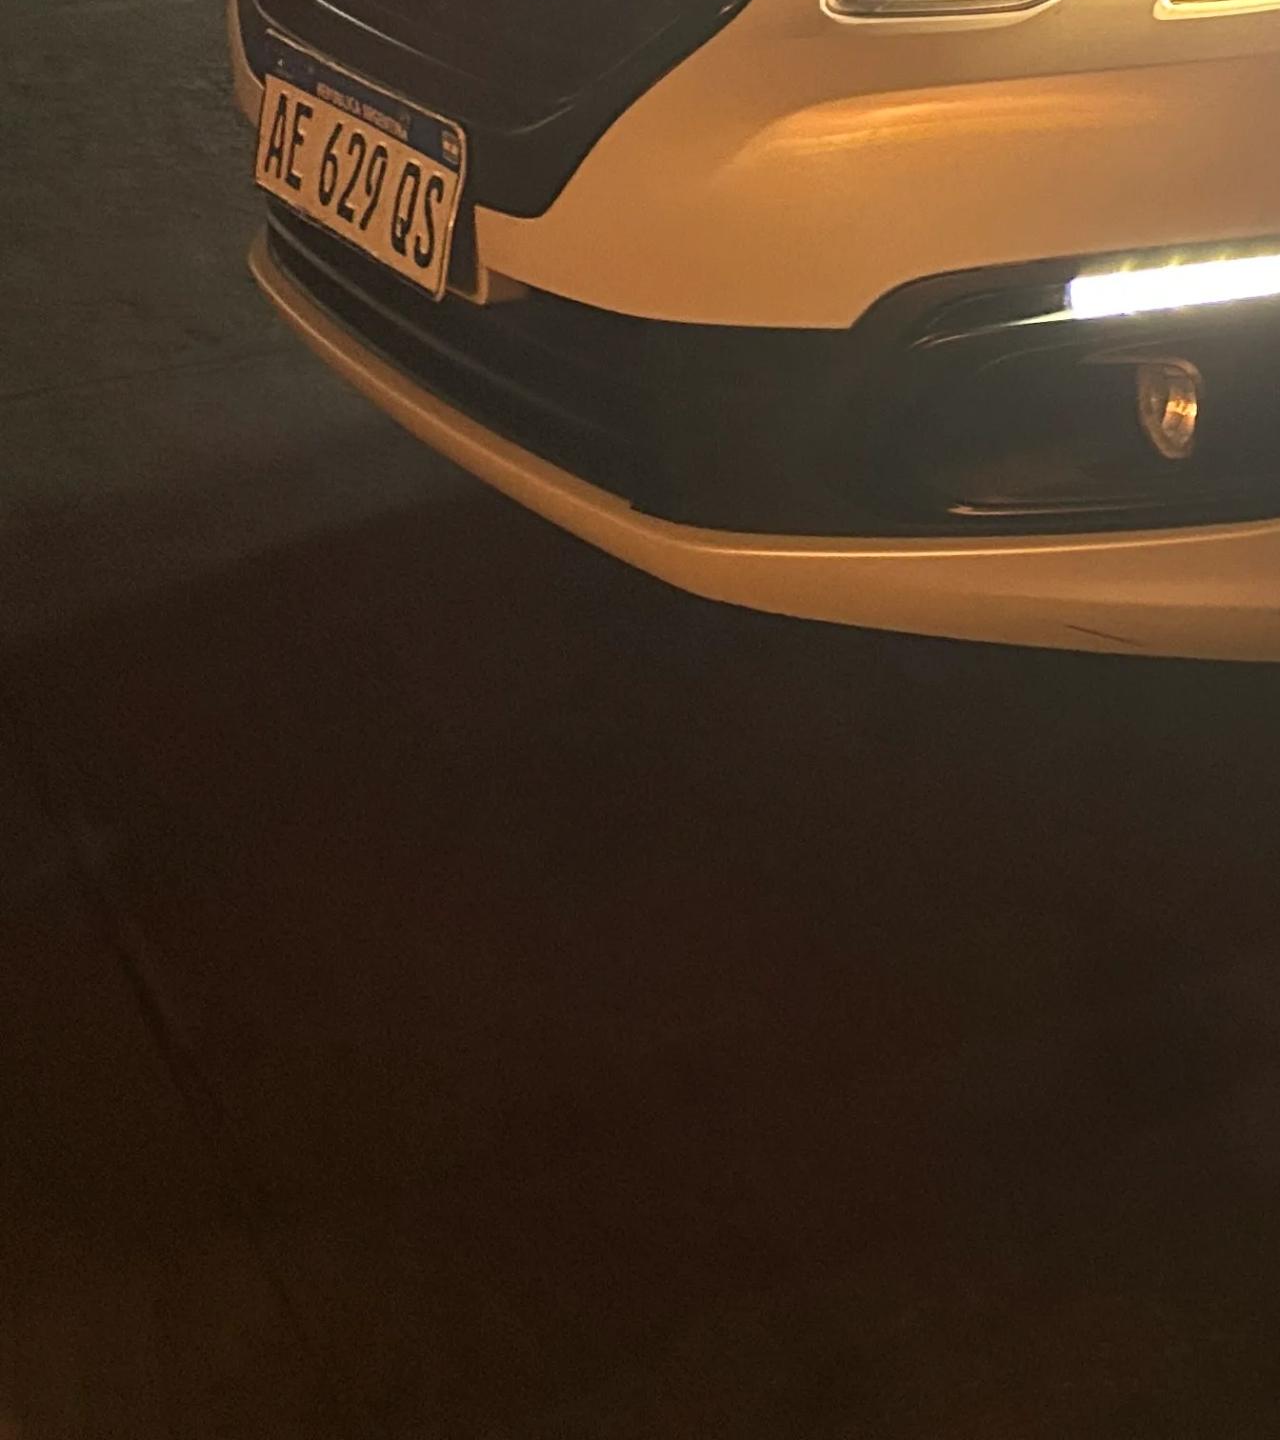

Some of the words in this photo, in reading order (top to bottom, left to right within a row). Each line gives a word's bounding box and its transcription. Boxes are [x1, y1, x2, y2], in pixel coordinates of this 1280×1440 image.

[264, 93, 313, 191] AE
[319, 122, 388, 231] 629
[391, 162, 444, 269] QS
